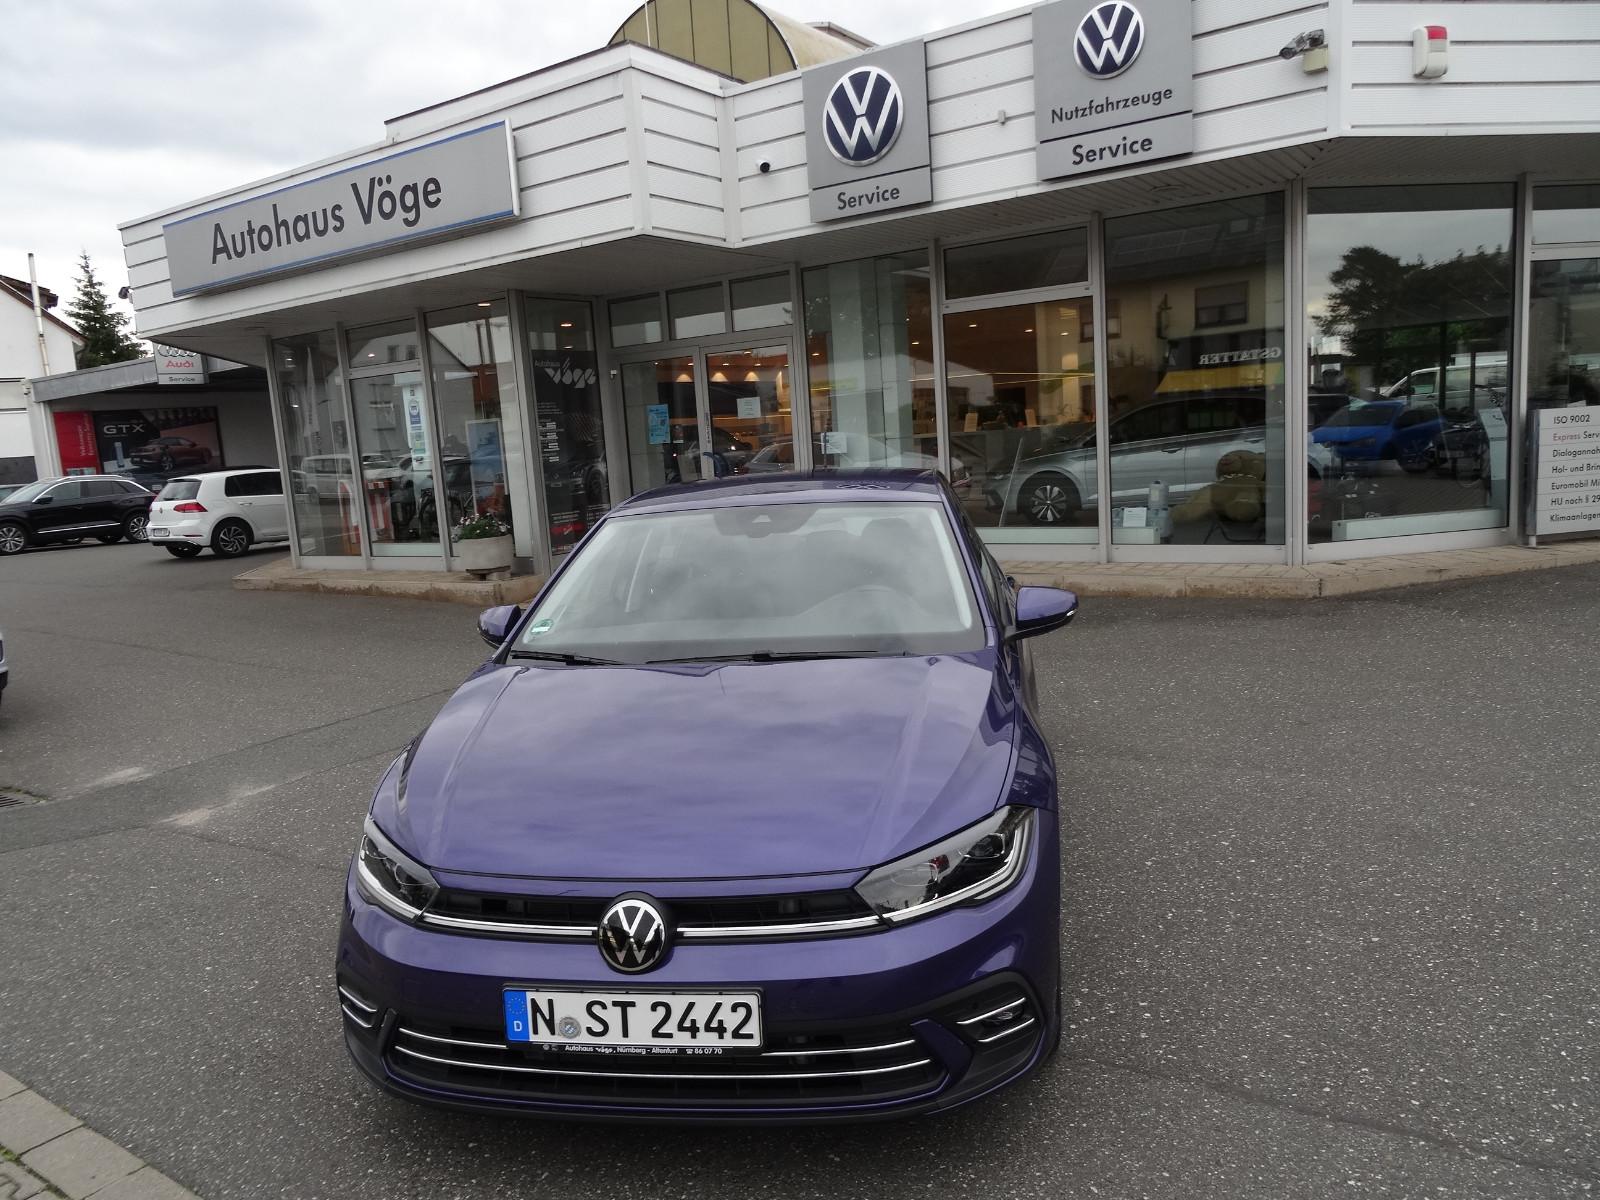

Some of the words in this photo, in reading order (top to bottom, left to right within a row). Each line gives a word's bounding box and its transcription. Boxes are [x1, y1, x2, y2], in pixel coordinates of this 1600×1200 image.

[1051, 88, 1173, 123] Nutzfahrzeuge
[1072, 136, 1153, 165] Service
[837, 185, 900, 210] Service
[211, 203, 345, 265] Autohaus
[350, 174, 442, 228] Vöge
[166, 360, 194, 368] Audi
[1553, 415, 1568, 424] ISO
[1569, 414, 1591, 424] 9002
[103, 423, 145, 434] GTX
[1553, 432, 1581, 442] Express
[1551, 465, 1568, 474] Hol-
[1569, 464, 1584, 472] und
[1551, 479, 1589, 490] Euromobil
[1550, 497, 1563, 506] HU
[1565, 496, 1583, 505] nach
[530, 997, 556, 1036] N
[585, 1000, 637, 1039] ST
[650, 1001, 755, 1040] 2442
[513, 1020, 523, 1032] D
[616, 1046, 647, 1055] Nürnberg
[651, 1047, 678, 1055] Altenfurt
